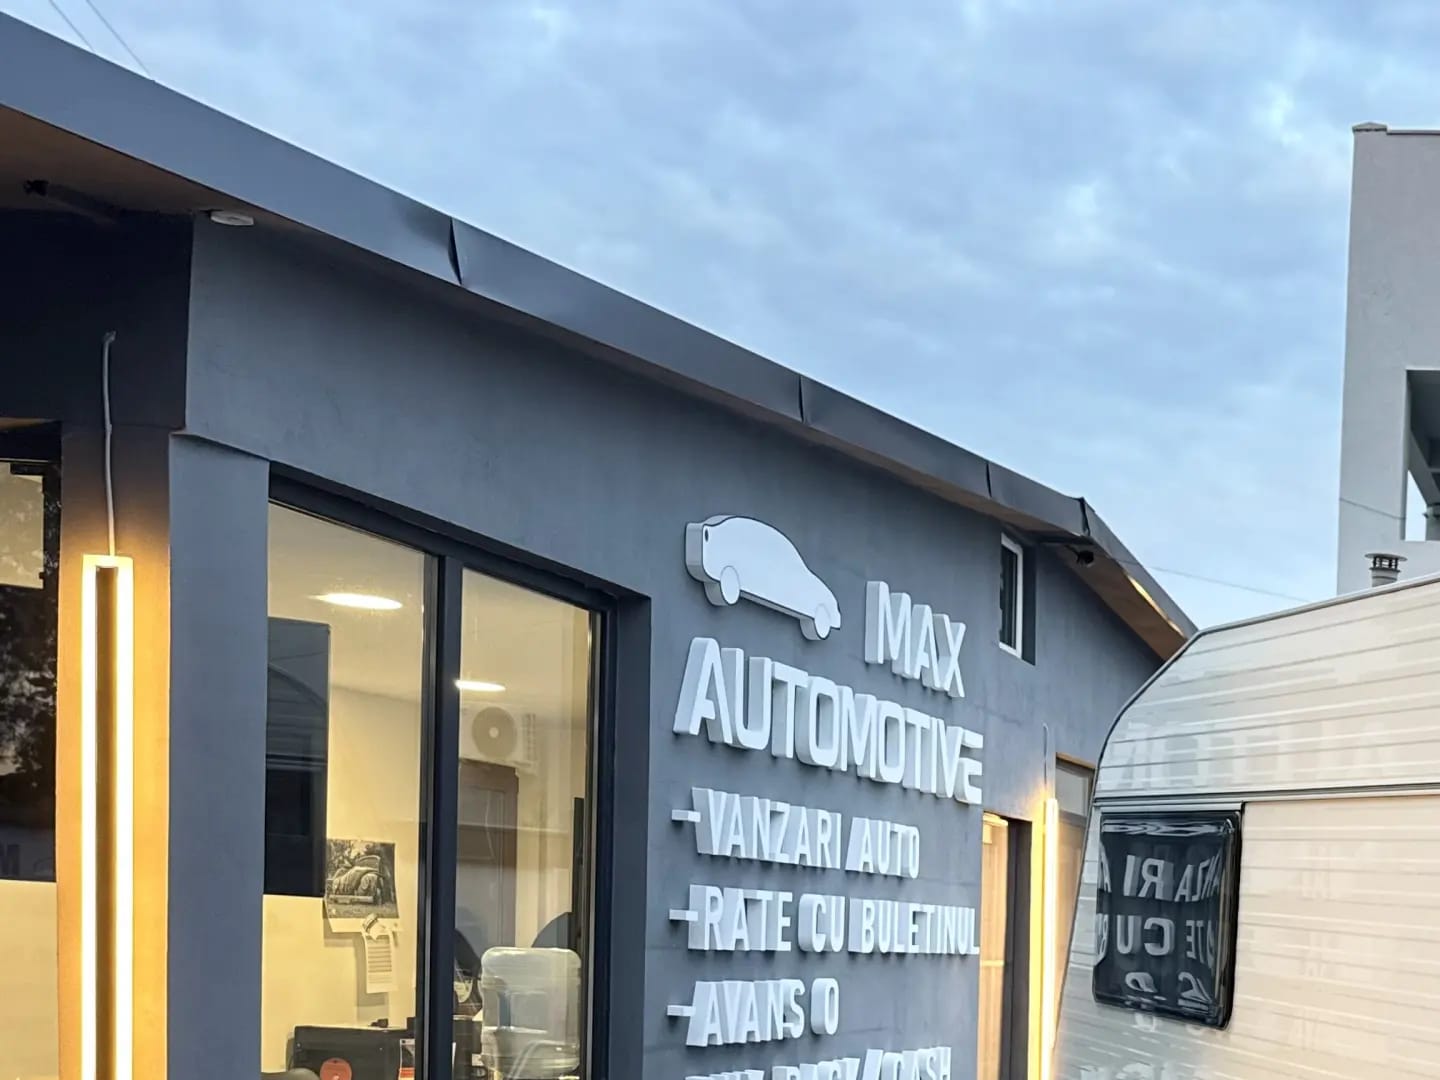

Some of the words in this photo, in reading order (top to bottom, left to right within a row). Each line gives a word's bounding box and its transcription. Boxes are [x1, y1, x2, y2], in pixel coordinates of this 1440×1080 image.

[865, 580, 966, 698] MAX
[673, 637, 984, 804] AUTOMOTIVE
[845, 816, 920, 879] AUTO
[798, 893, 846, 953] CU
[848, 897, 980, 955] BULETINUL
